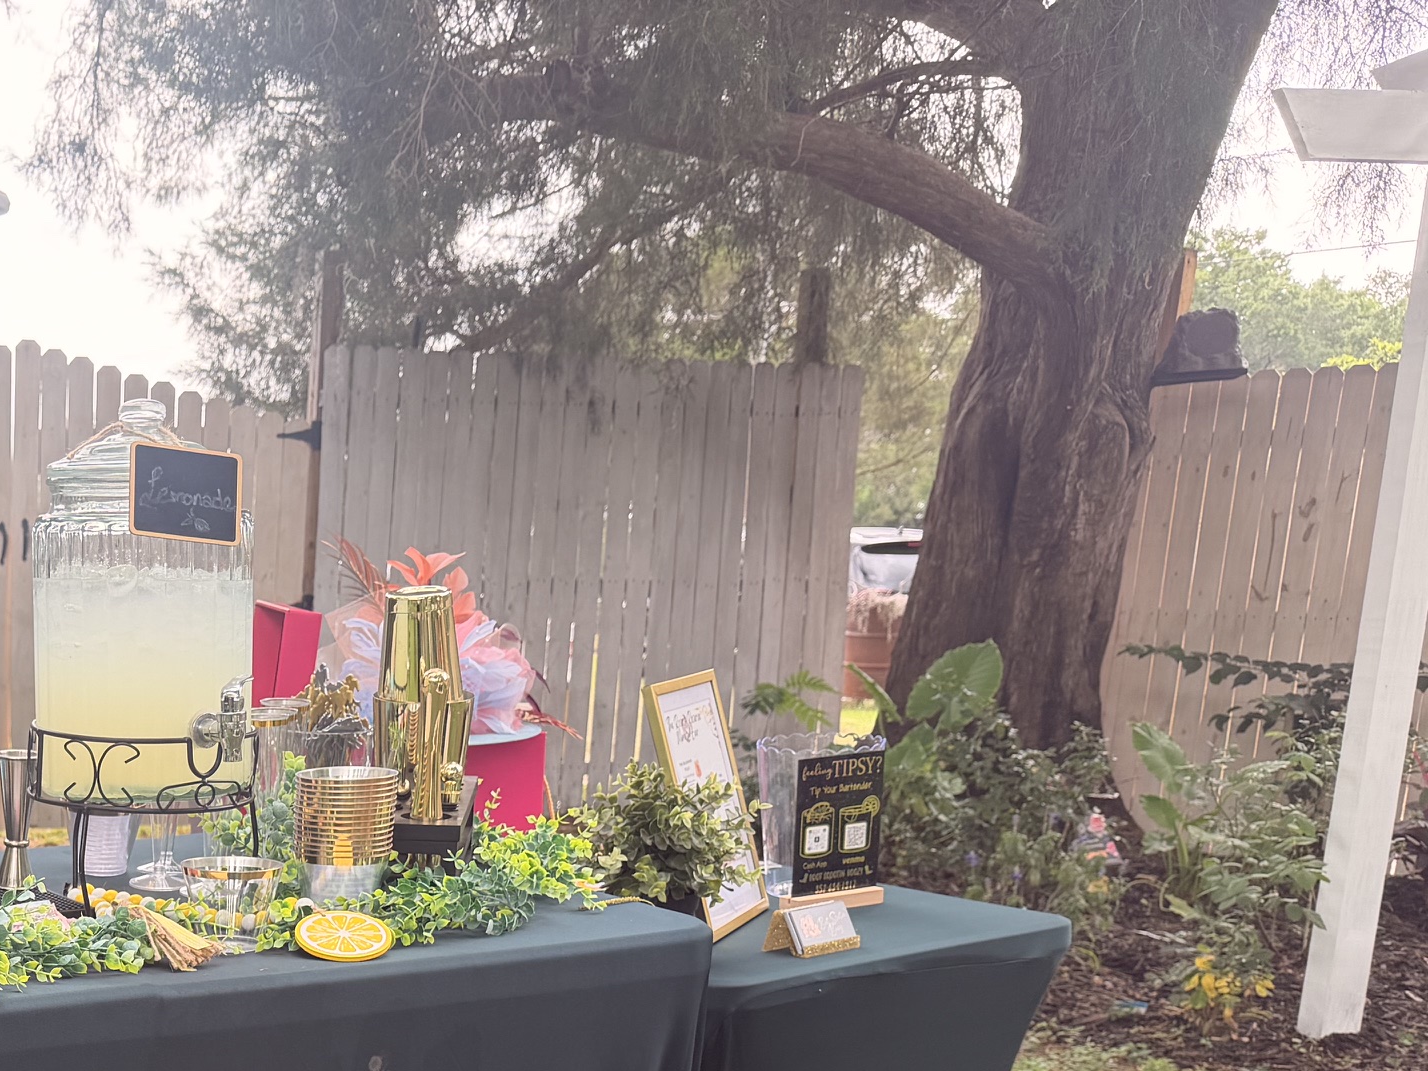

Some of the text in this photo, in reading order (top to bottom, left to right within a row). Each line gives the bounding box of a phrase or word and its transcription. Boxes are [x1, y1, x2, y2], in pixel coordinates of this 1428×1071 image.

[139, 466, 236, 512] Lemonade
[802, 756, 883, 781] feeling TIPSY?
[810, 781, 873, 798] Tip Your Bartender
